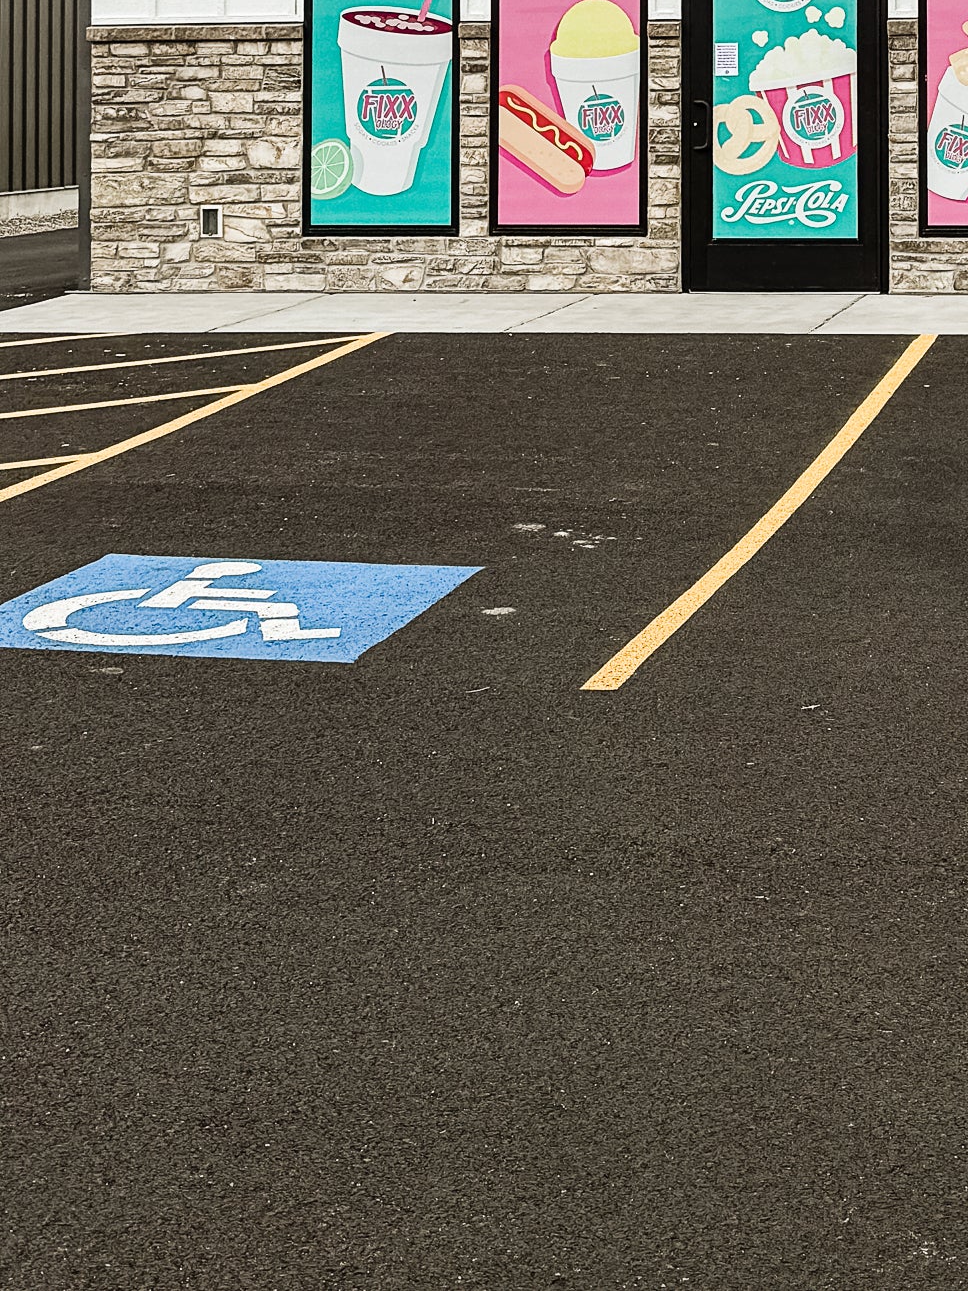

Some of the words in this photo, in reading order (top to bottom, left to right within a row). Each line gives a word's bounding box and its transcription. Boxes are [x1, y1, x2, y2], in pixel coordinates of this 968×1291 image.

[363, 95, 415, 120] FIXX
[583, 105, 621, 128] FIXX
[794, 103, 834, 129] FIXX
